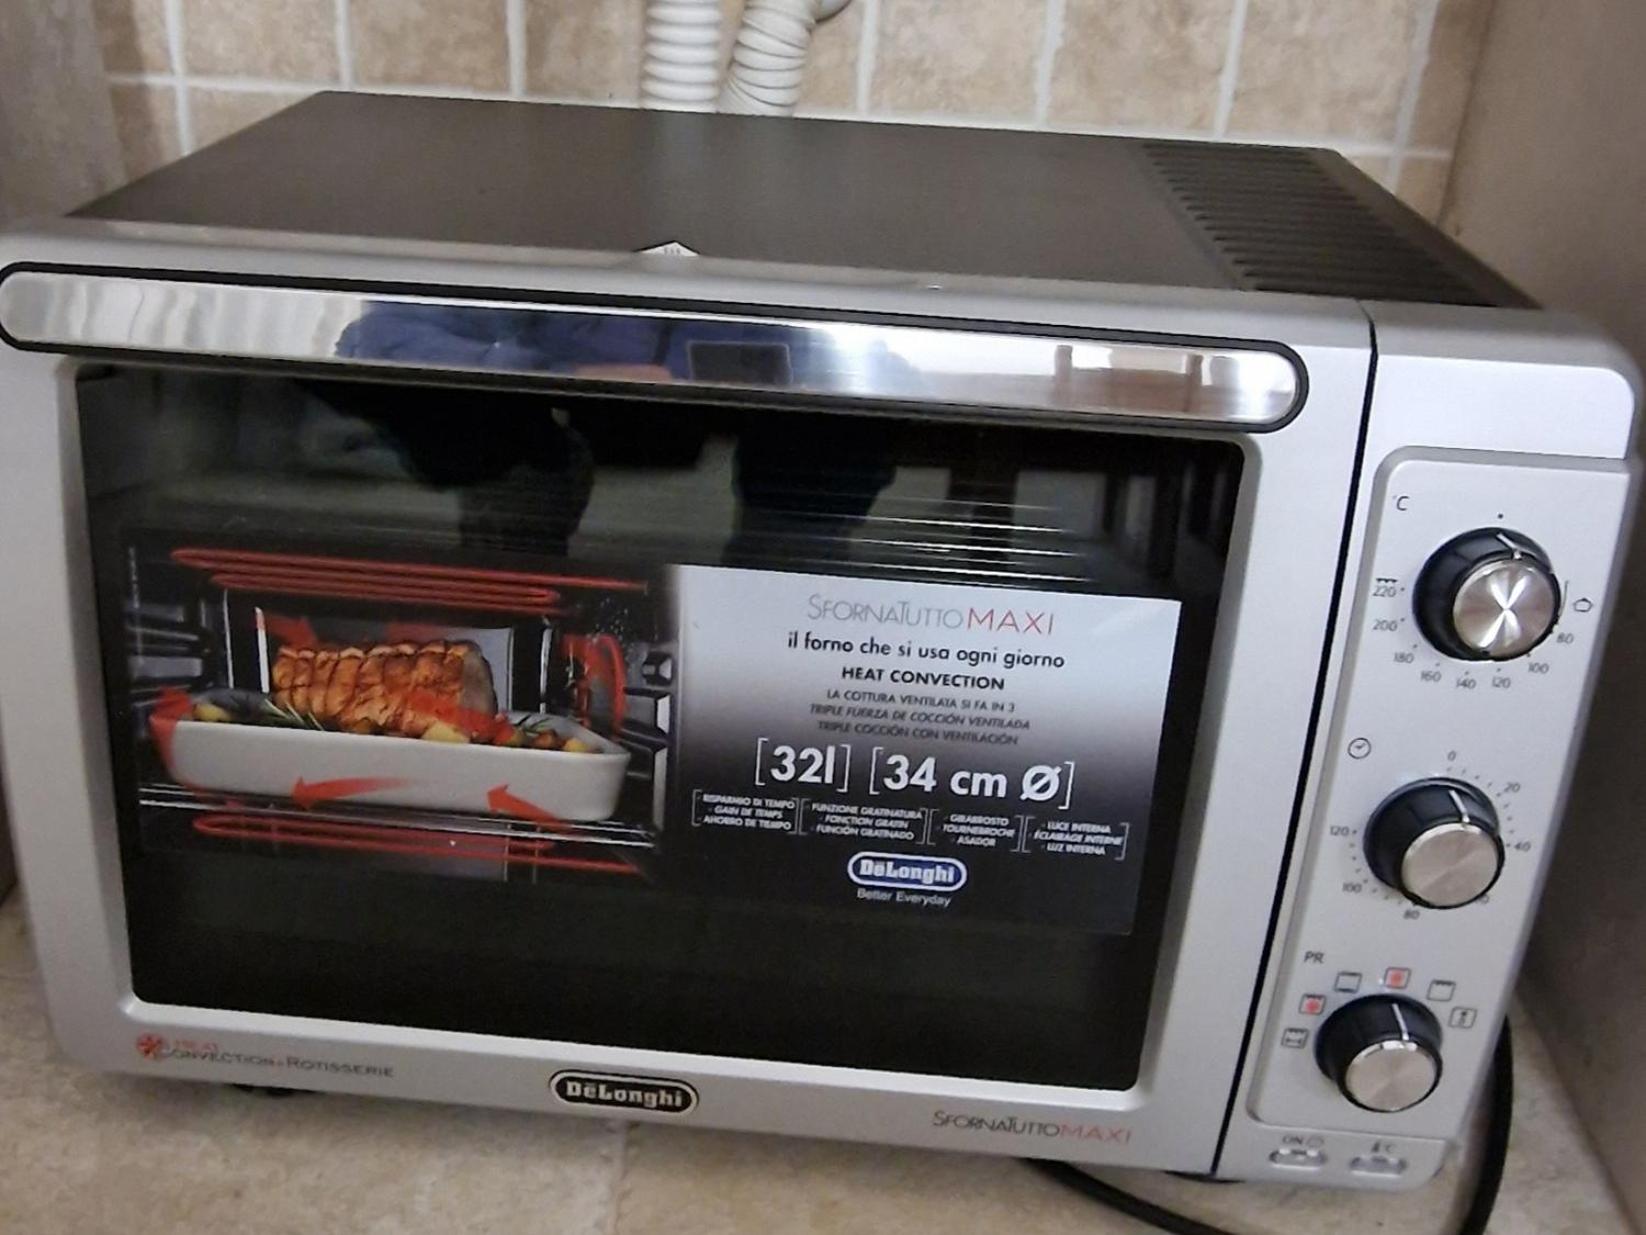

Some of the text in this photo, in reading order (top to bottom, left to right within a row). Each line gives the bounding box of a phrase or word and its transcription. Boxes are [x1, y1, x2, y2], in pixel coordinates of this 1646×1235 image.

[1373, 586, 1396, 597] 220
[968, 607, 1054, 635] MAXI
[1373, 620, 1398, 632] 200
[1556, 633, 1573, 644] 80
[788, 631, 1065, 669] il forno che si usa ogni giorno
[1394, 652, 1414, 663] 180
[1529, 662, 1549, 674] 100
[842, 667, 1005, 690] HEAT CONVECTION
[1420, 670, 1441, 682] 160
[1455, 677, 1476, 689] 140
[1491, 677, 1511, 689] 120
[827, 689, 840, 700] LA
[844, 690, 896, 704] COTTURA
[900, 695, 957, 709] VENTILATA
[974, 700, 988, 711] FA
[810, 703, 843, 717] TRIPLE
[846, 706, 888, 720] FUERZA
[893, 710, 908, 721] DE
[969, 715, 1031, 730] VENTILADA
[819, 720, 850, 733] TRIPLE
[913, 727, 939, 739] CON
[950, 769, 1007, 798] cm
[1504, 782, 1521, 793] 20
[765, 798, 795, 810] TEMPO
[1329, 826, 1350, 837] 120
[1513, 841, 1531, 852] 40
[1342, 883, 1362, 894] 100
[896, 891, 952, 907] Everyday
[1403, 909, 1420, 920] 80
[1304, 951, 1324, 964] PR
[1282, 1135, 1304, 1146] ON
